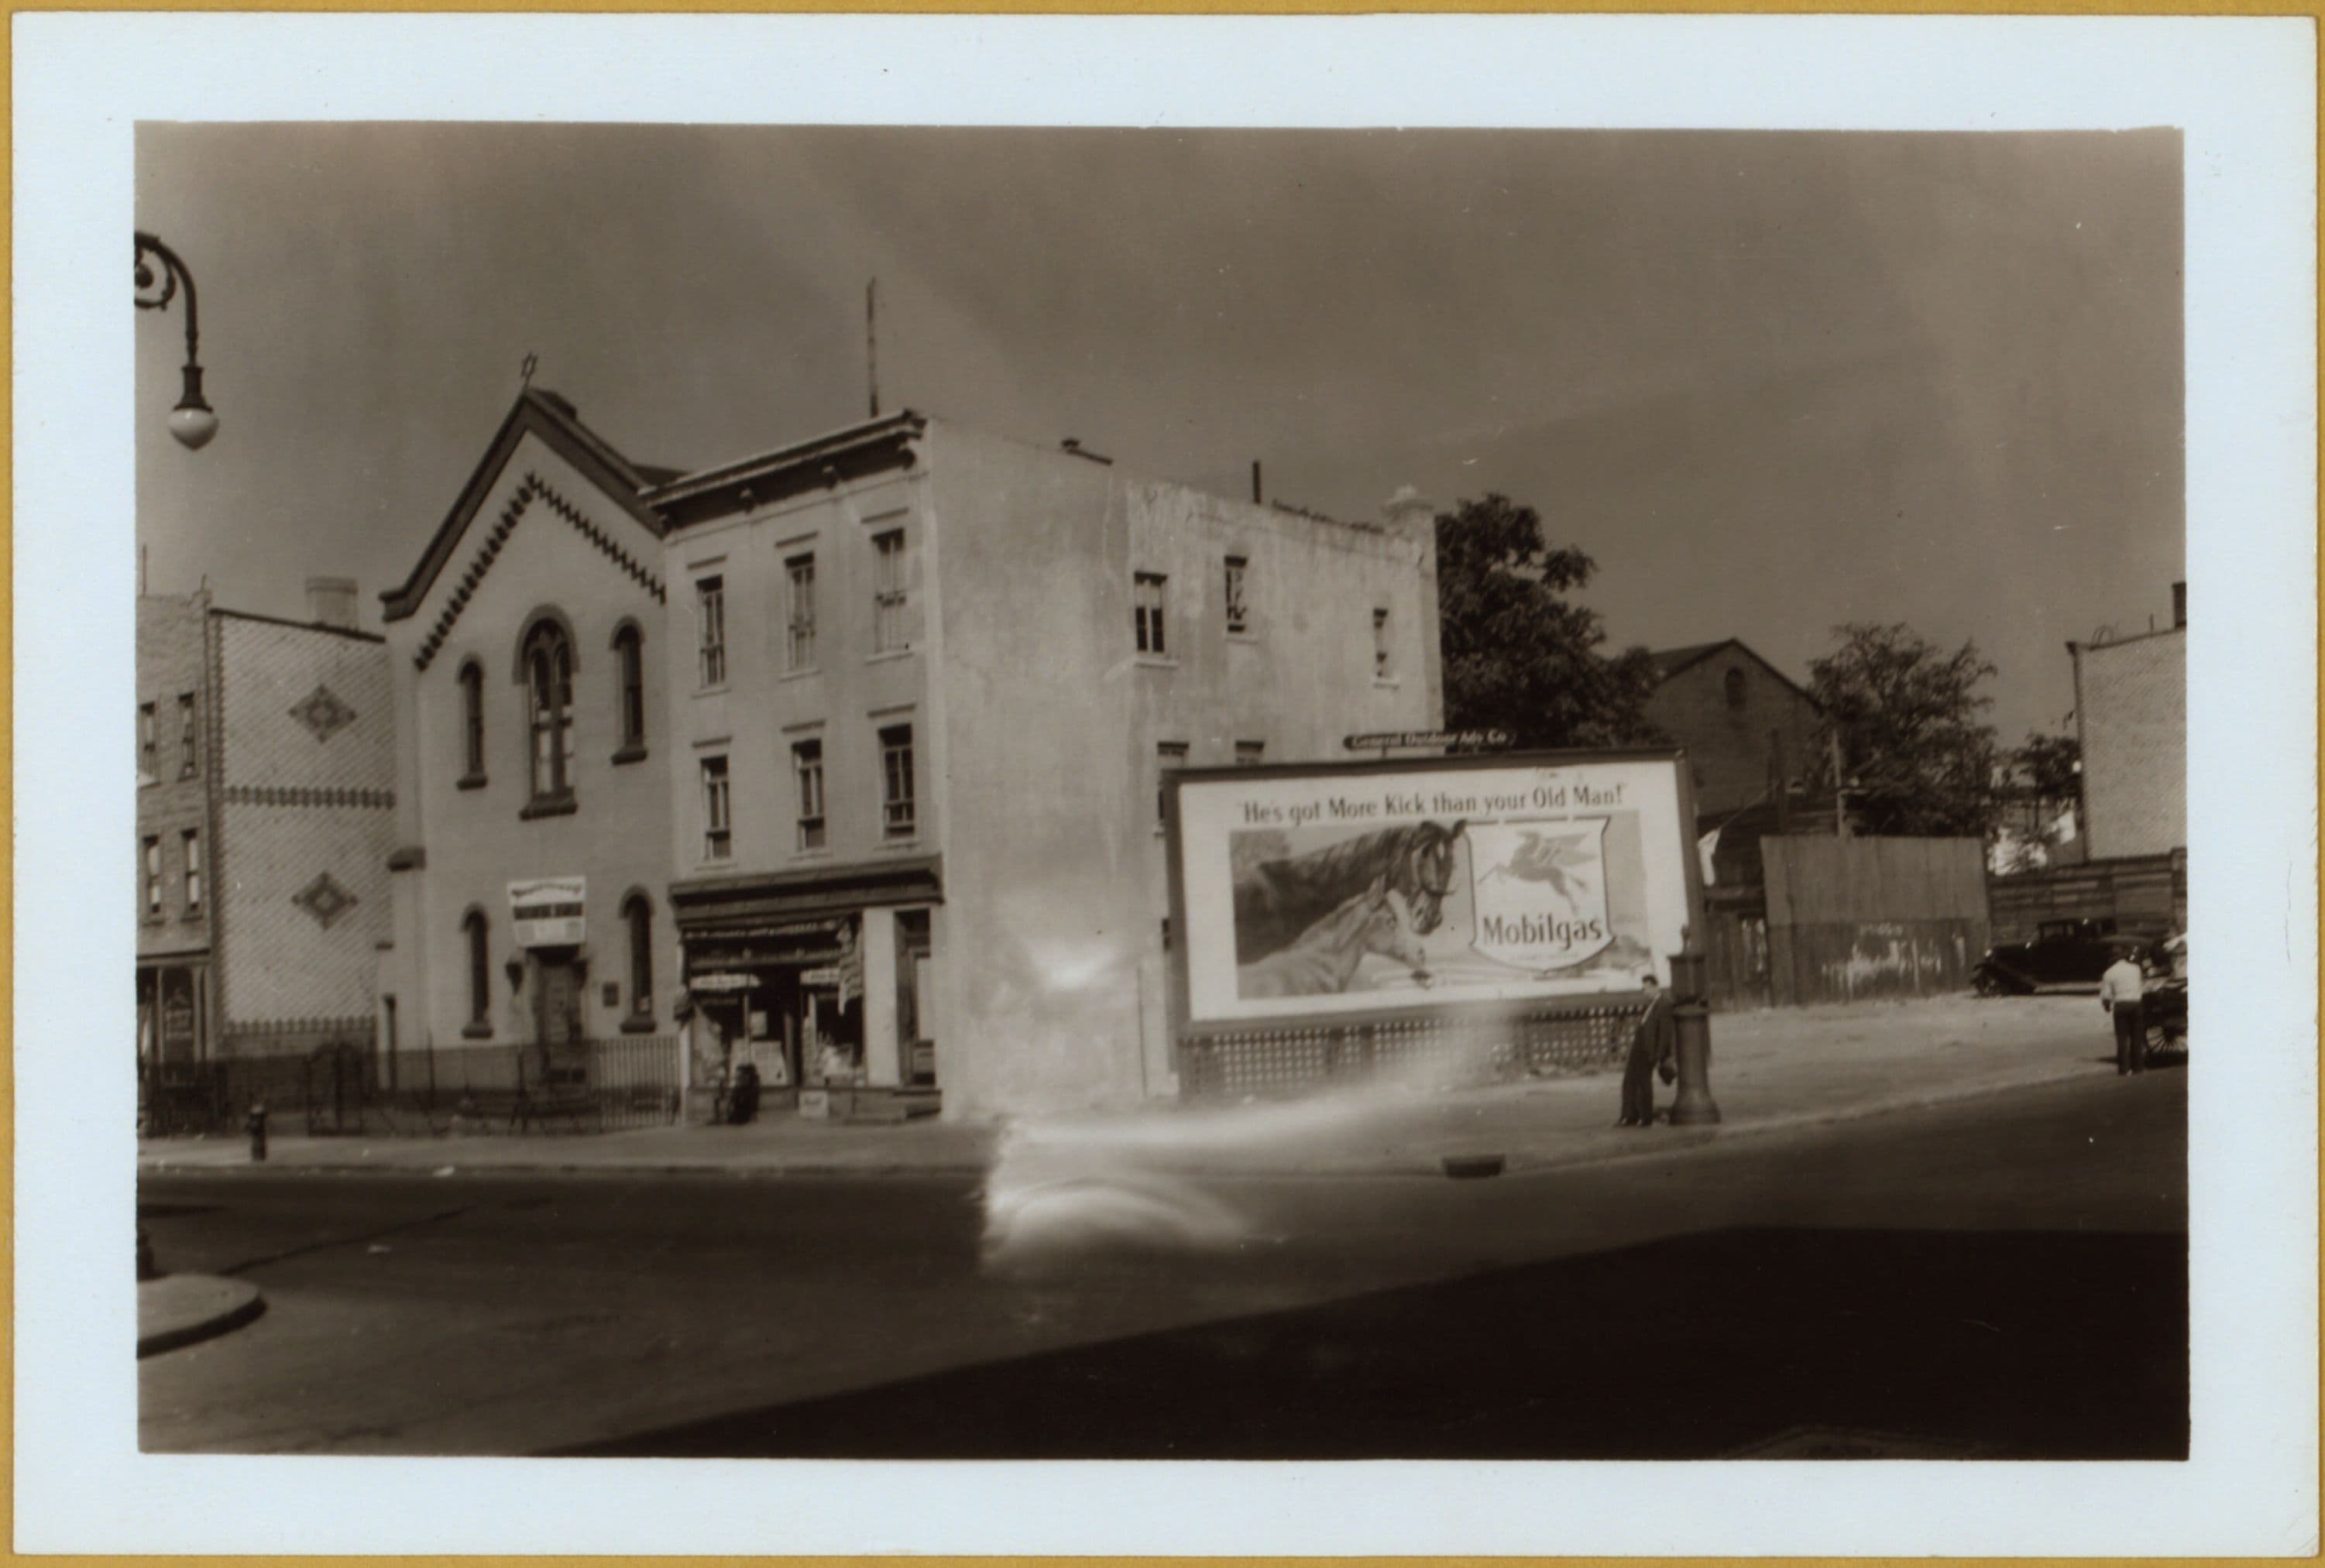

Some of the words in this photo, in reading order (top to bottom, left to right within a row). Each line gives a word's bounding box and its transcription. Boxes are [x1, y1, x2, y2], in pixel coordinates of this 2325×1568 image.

[1290, 801, 1320, 827] got
[1328, 796, 1377, 819] More
[1385, 792, 1426, 815] Kick
[1433, 791, 1477, 813] than
[1484, 792, 1526, 816] your
[1533, 785, 1566, 808] Old
[1483, 911, 1602, 950] Mobilgas
